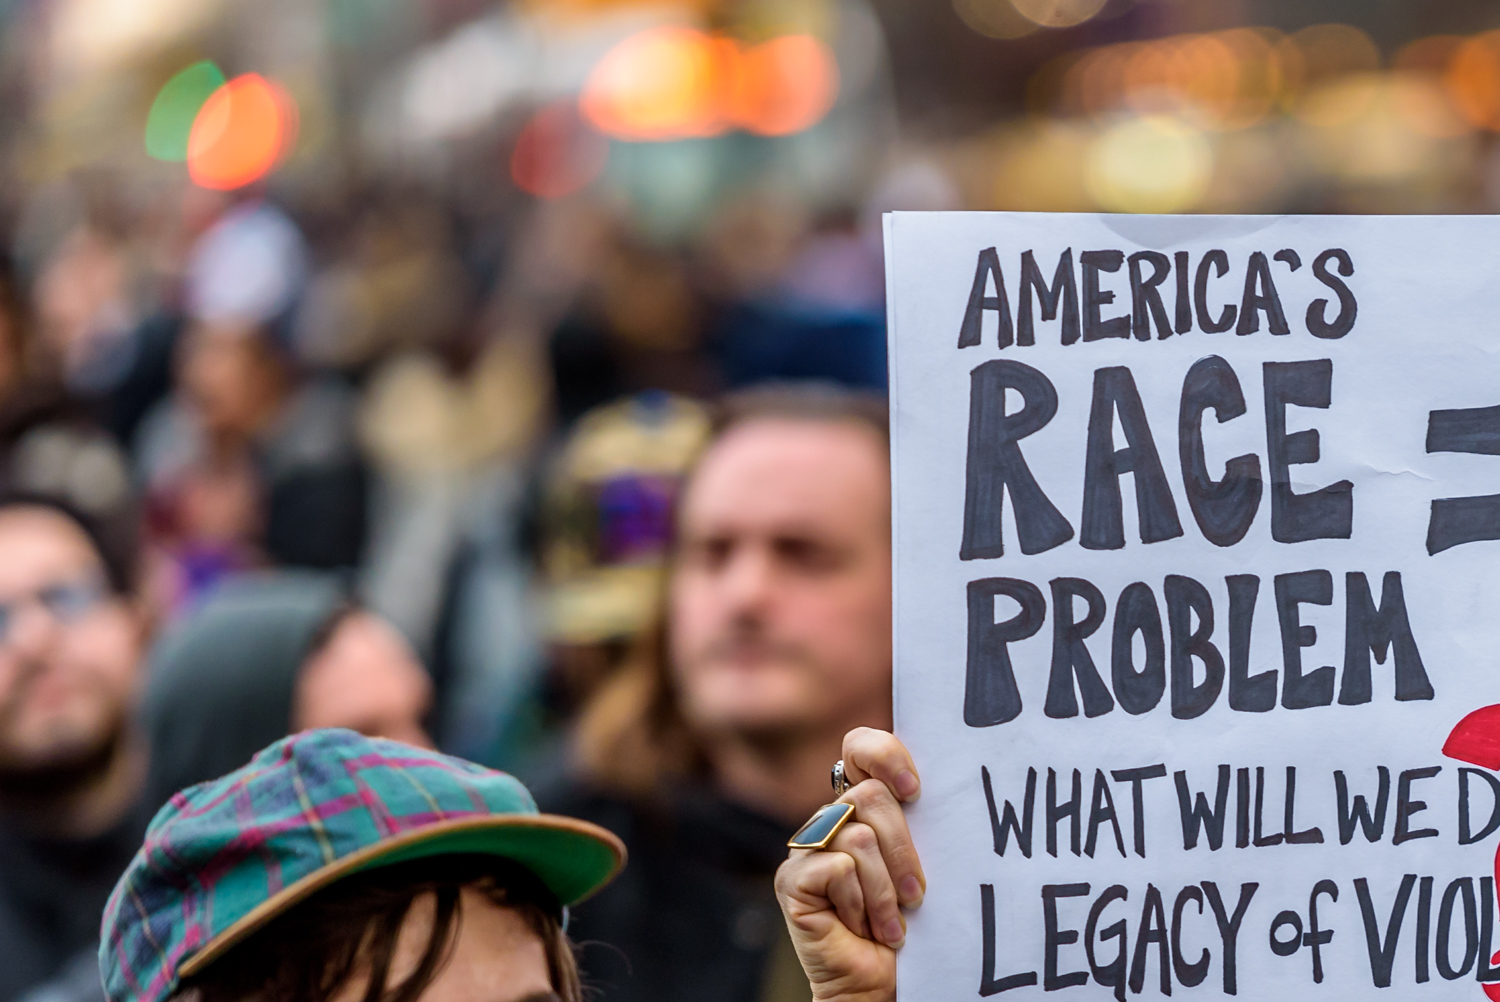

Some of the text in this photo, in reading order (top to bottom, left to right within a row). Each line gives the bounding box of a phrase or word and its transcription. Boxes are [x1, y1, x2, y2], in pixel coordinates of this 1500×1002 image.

[957, 246, 1358, 349] AMERICA'S
[960, 354, 1355, 561] RACE
[963, 569, 1435, 728] PROBLEM
[981, 763, 1167, 859] WHAT
[1173, 764, 1325, 851] WILL
[1333, 765, 1443, 846] WE
[1269, 879, 1339, 984] of
